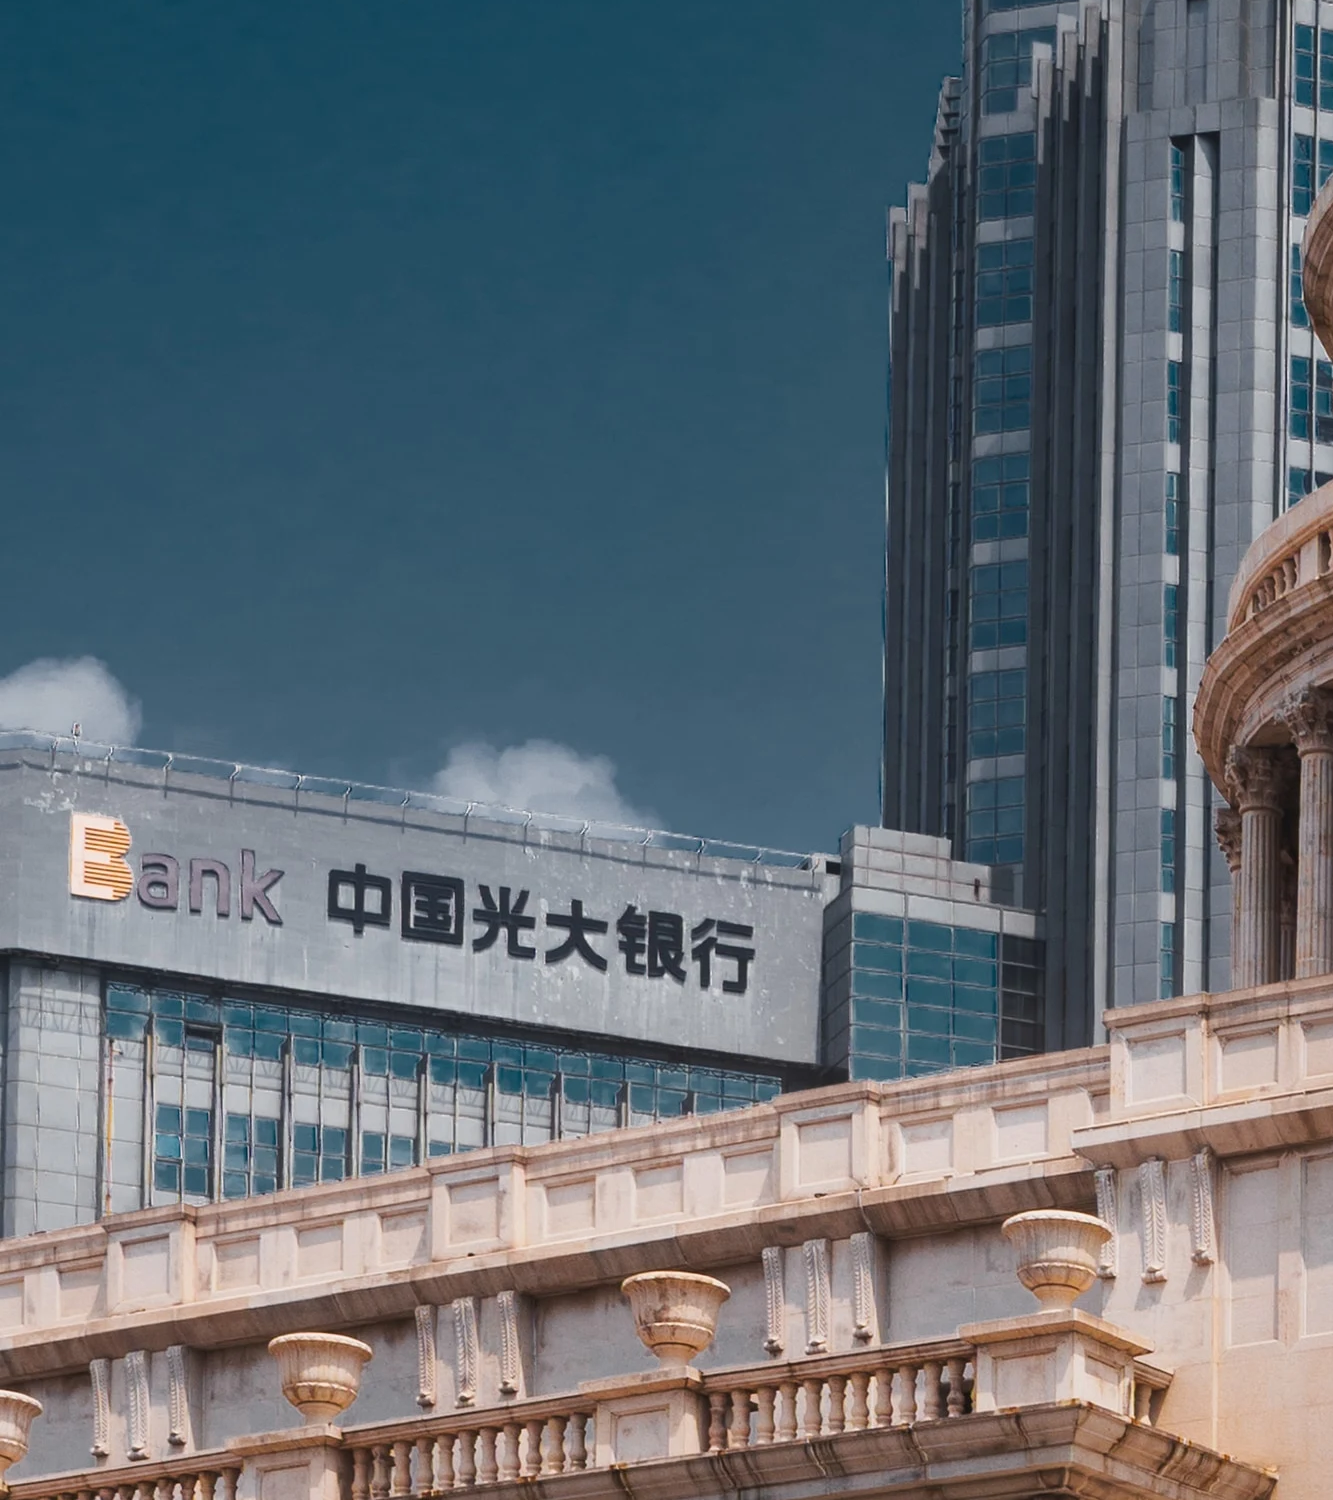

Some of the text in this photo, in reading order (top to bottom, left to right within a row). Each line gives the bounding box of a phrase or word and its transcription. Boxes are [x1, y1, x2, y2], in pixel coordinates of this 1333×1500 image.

[68, 811, 285, 926] Bank
[327, 863, 757, 994] 中国光大银行
